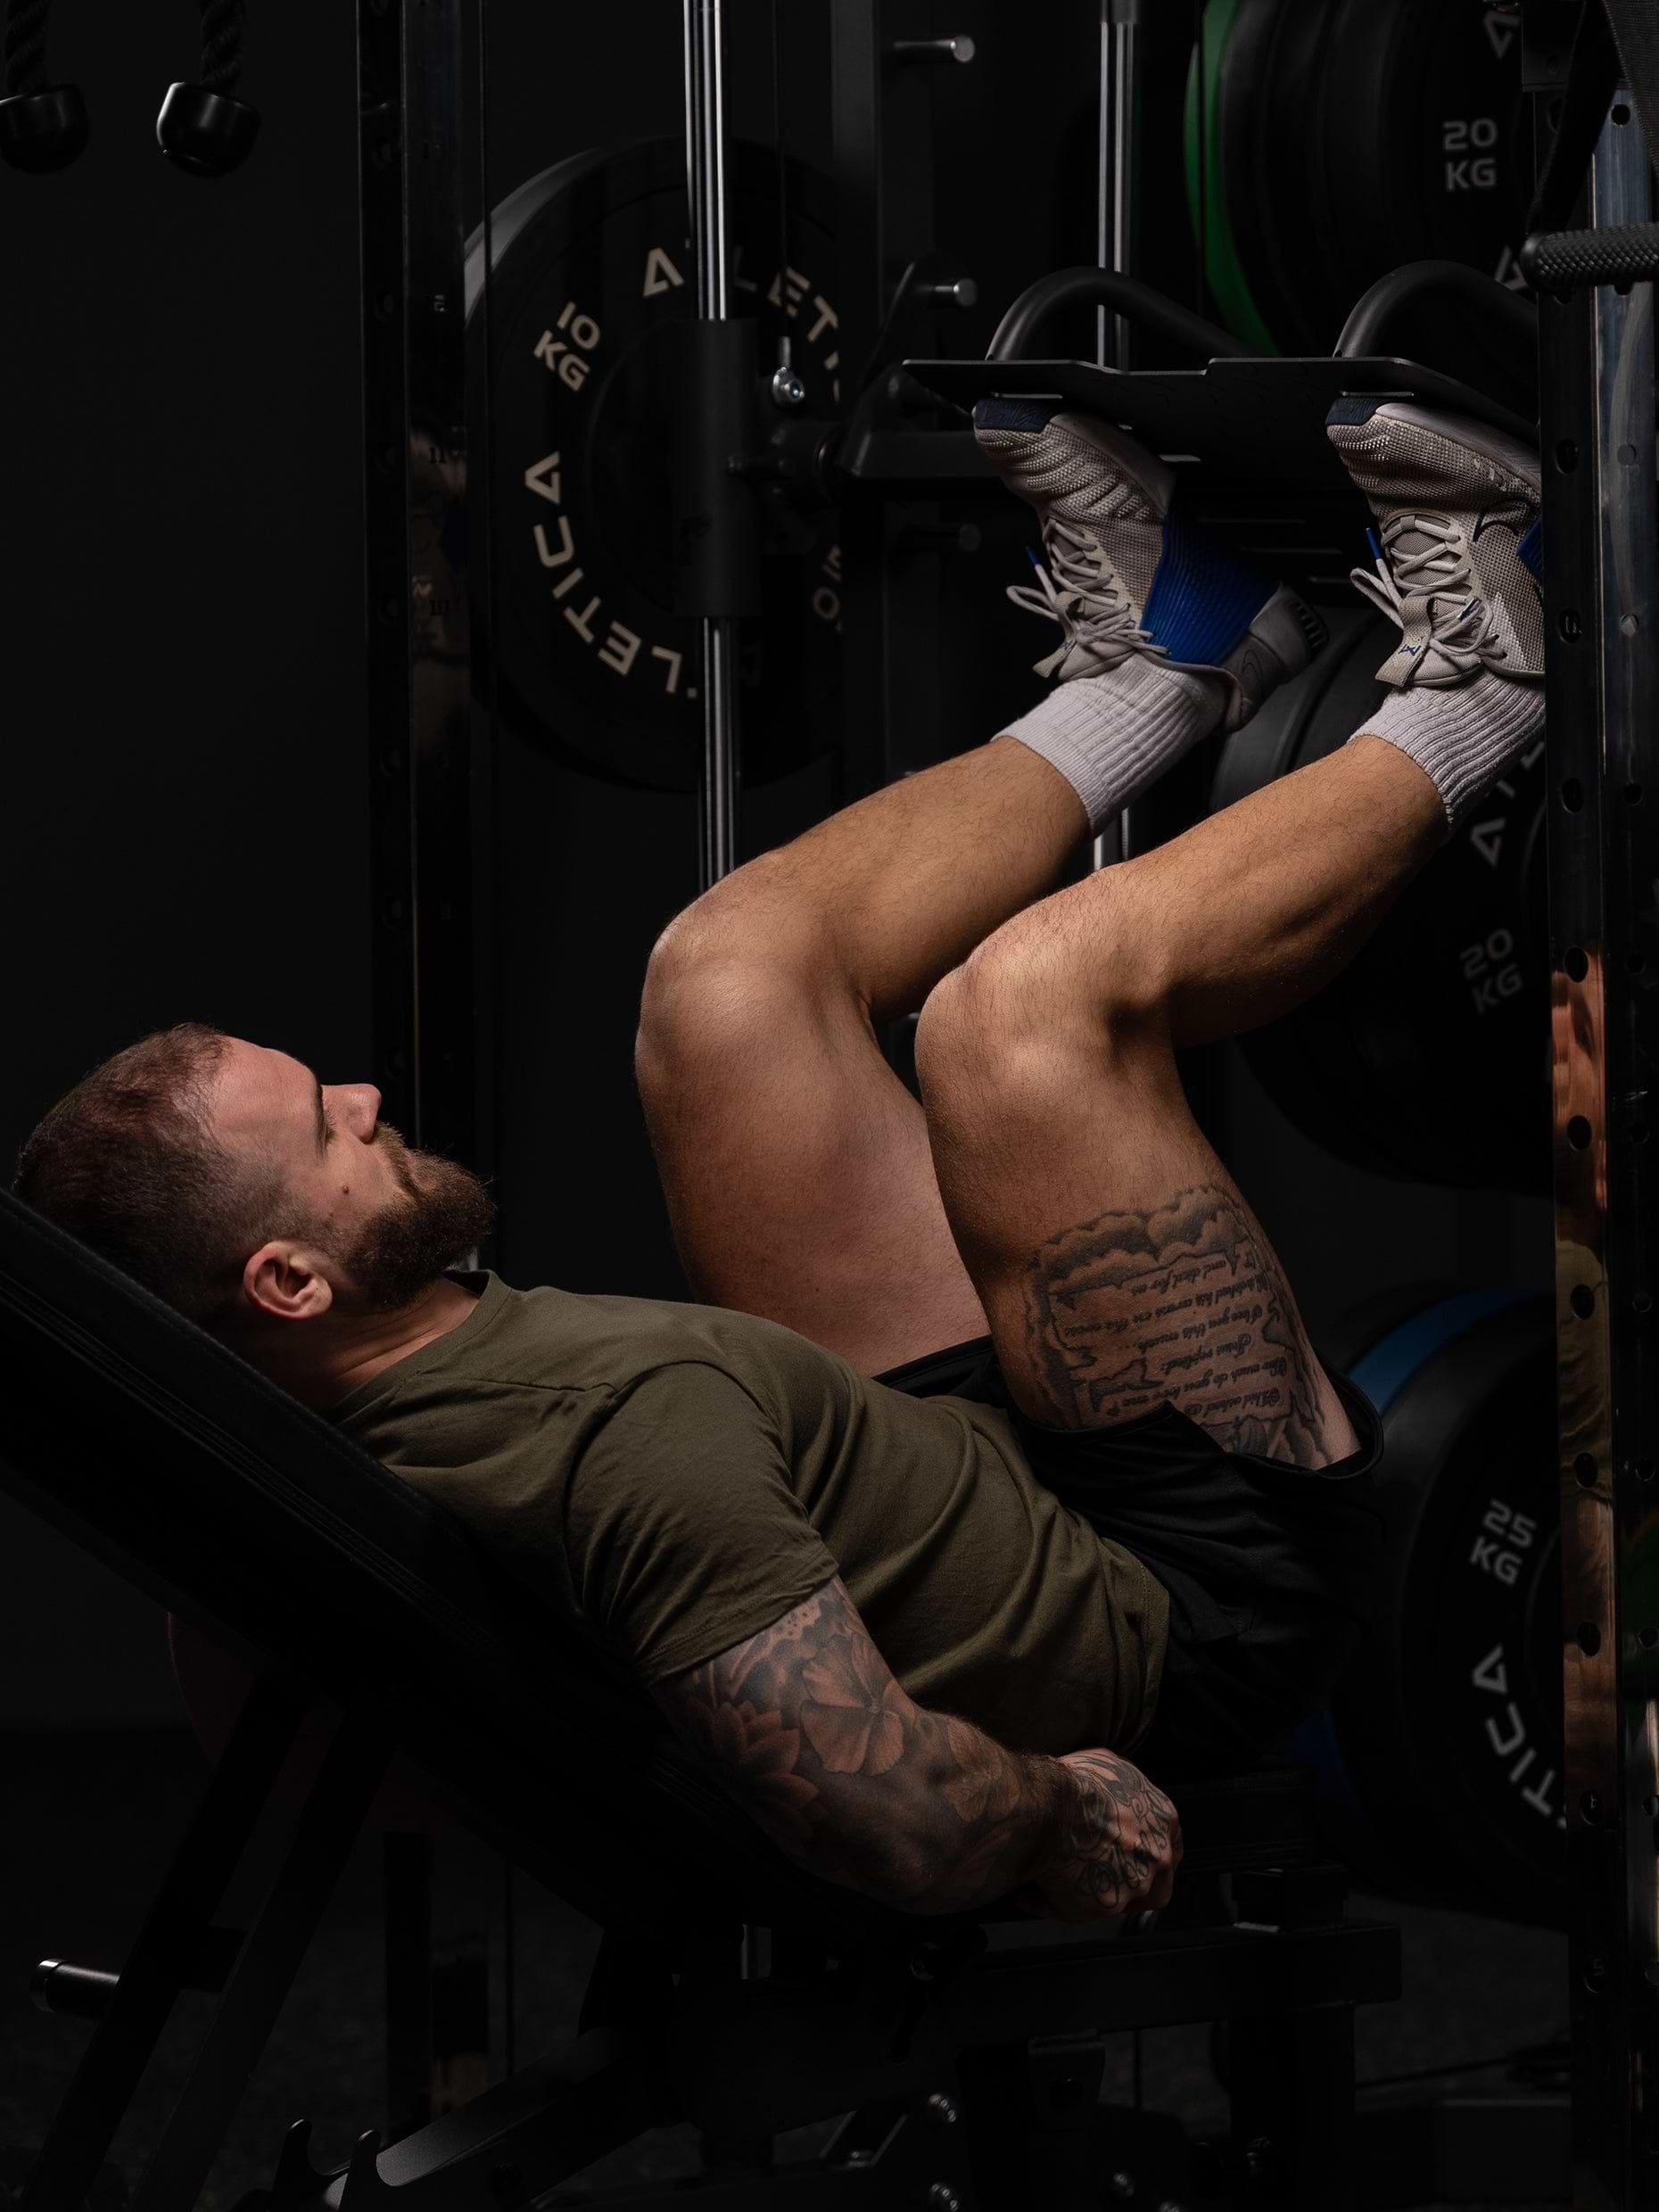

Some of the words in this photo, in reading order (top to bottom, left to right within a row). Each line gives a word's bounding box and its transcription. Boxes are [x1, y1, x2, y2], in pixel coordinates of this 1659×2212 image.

[1441, 117, 1499, 152] 20
[1444, 157, 1498, 193] KG
[556, 301, 601, 352] 10
[533, 330, 590, 393] KG
[1459, 927, 1515, 979] 20
[1472, 962, 1523, 1015] KG
[1482, 1498, 1539, 1550] 25
[1470, 1534, 1523, 1588] KG
